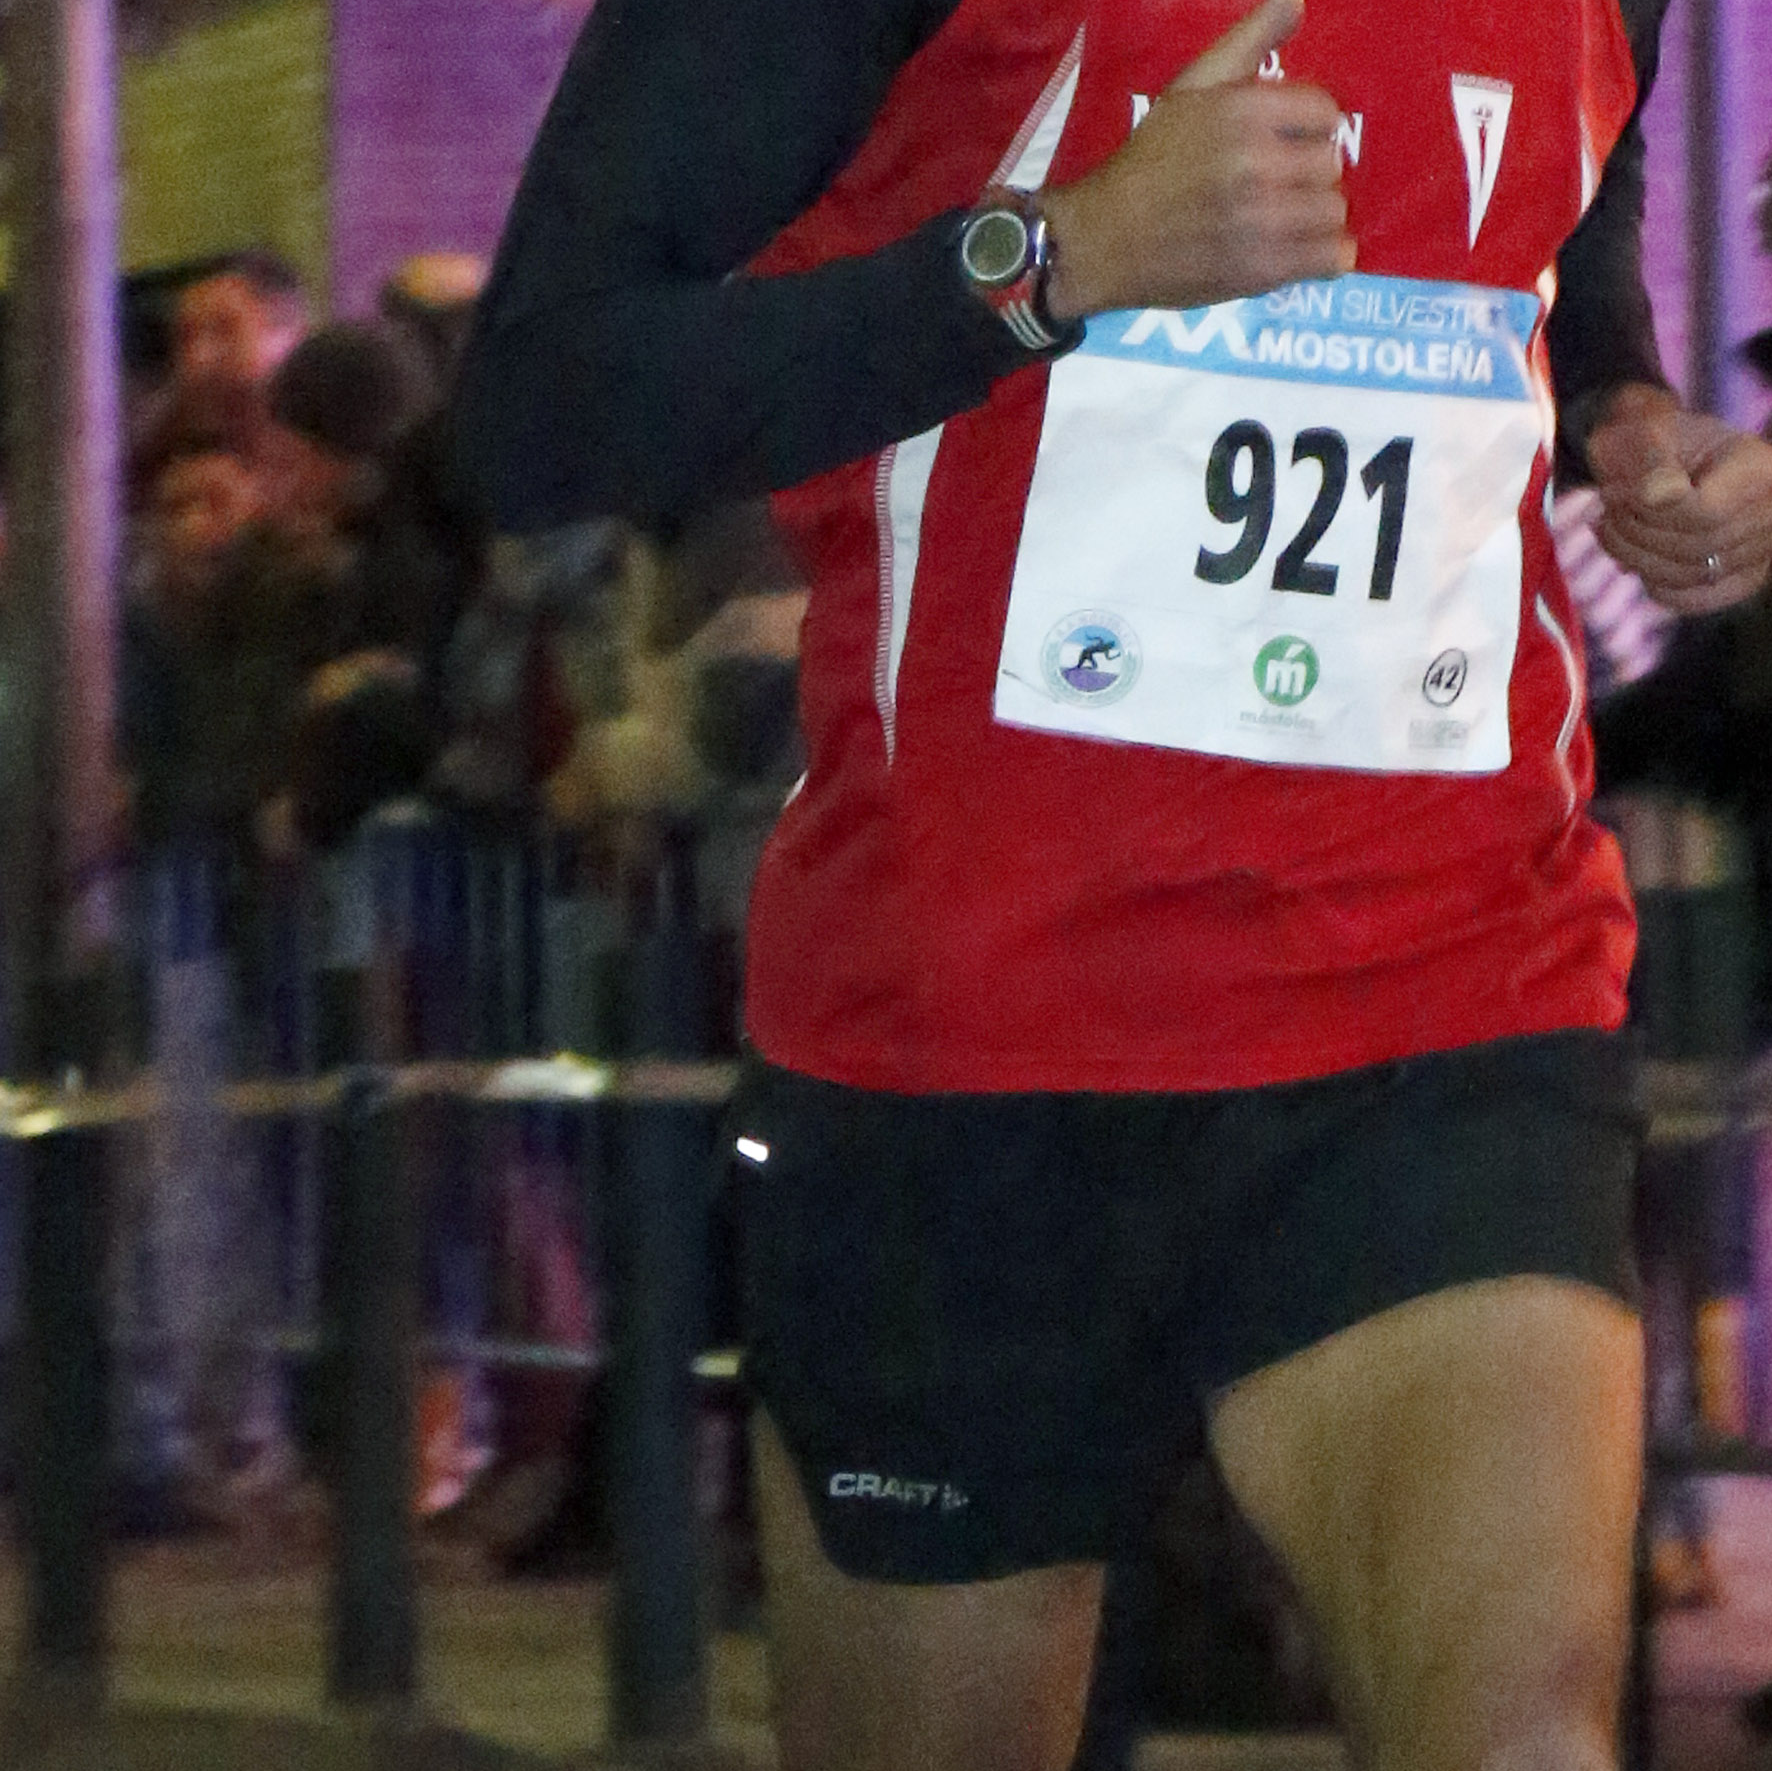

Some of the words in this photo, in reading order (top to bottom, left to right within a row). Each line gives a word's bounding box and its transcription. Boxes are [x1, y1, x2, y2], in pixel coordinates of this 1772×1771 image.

[1265, 283, 1334, 319] SAN
[1257, 327, 1494, 384] MOSTOLEÑA
[1194, 419, 1414, 601] 921
[828, 1472, 939, 1507] CRAFT
